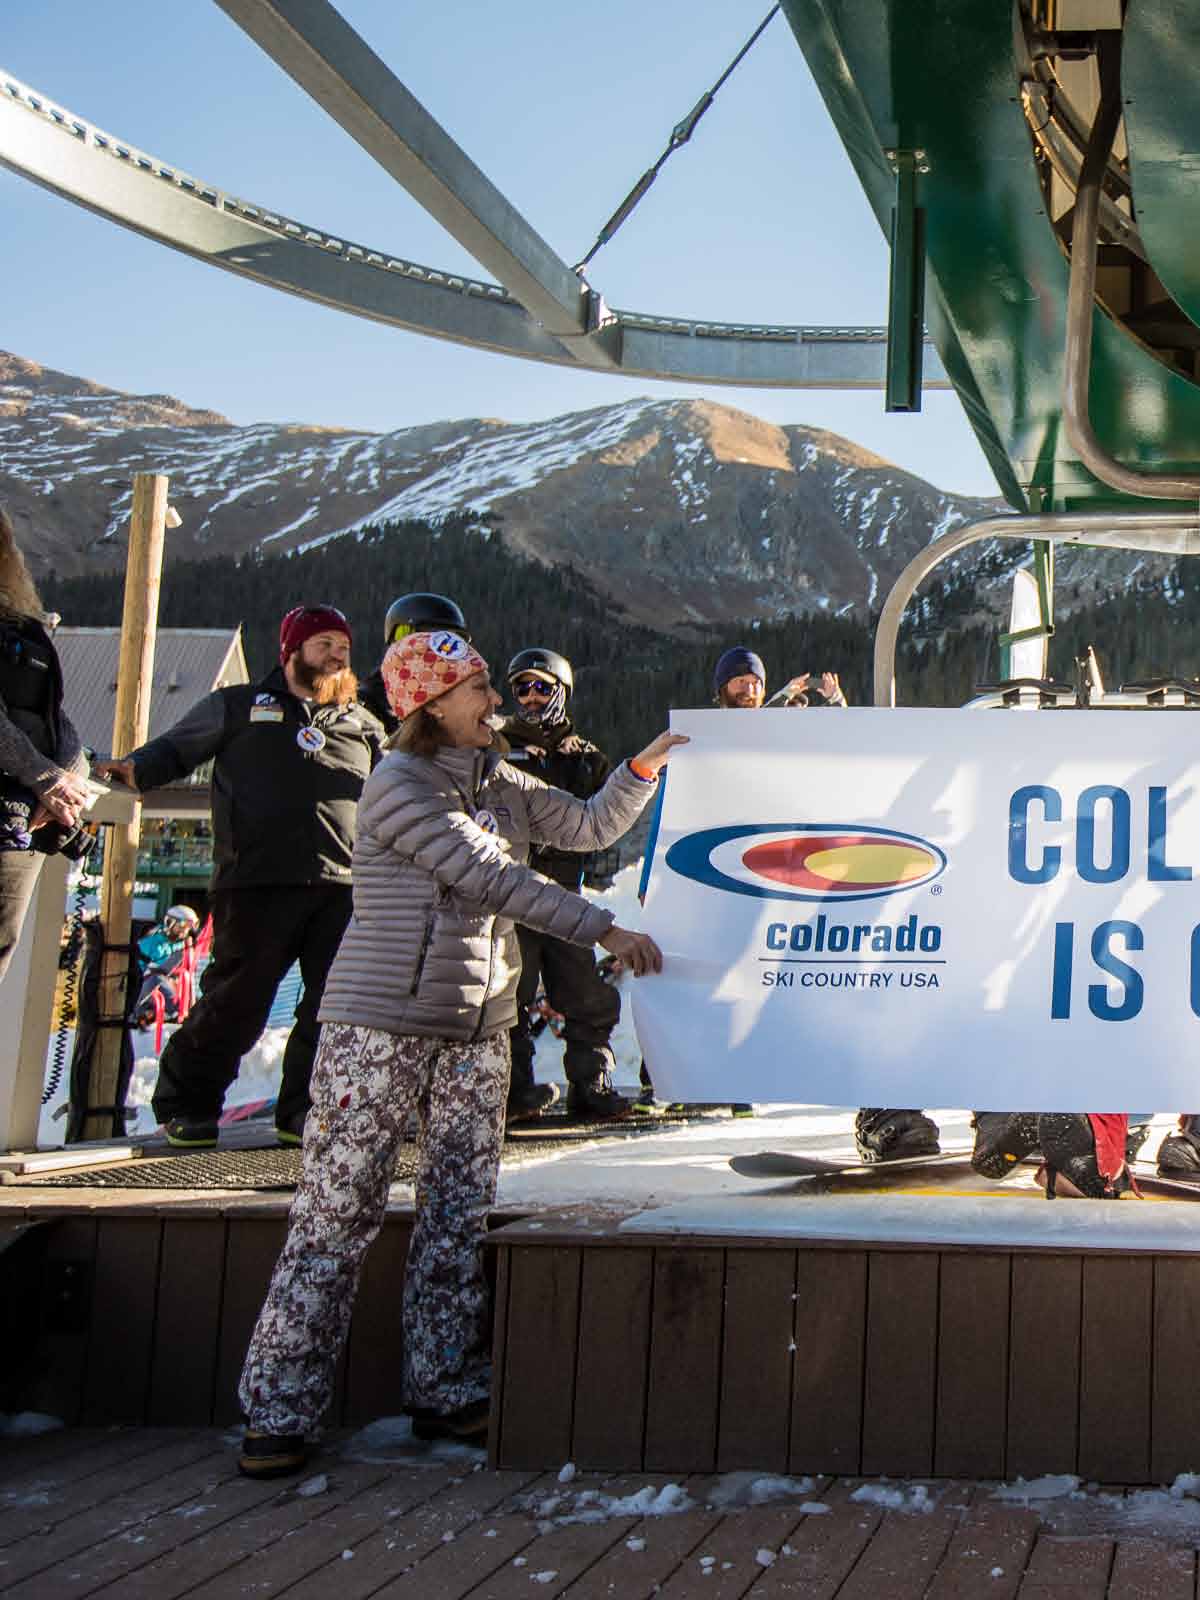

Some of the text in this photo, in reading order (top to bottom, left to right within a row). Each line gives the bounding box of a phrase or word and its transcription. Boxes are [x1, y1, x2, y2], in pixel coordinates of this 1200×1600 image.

[766, 914, 942, 953] colorado
[762, 971, 940, 988] SKI COUNTRY USA
[1050, 919, 1145, 1022] IS
